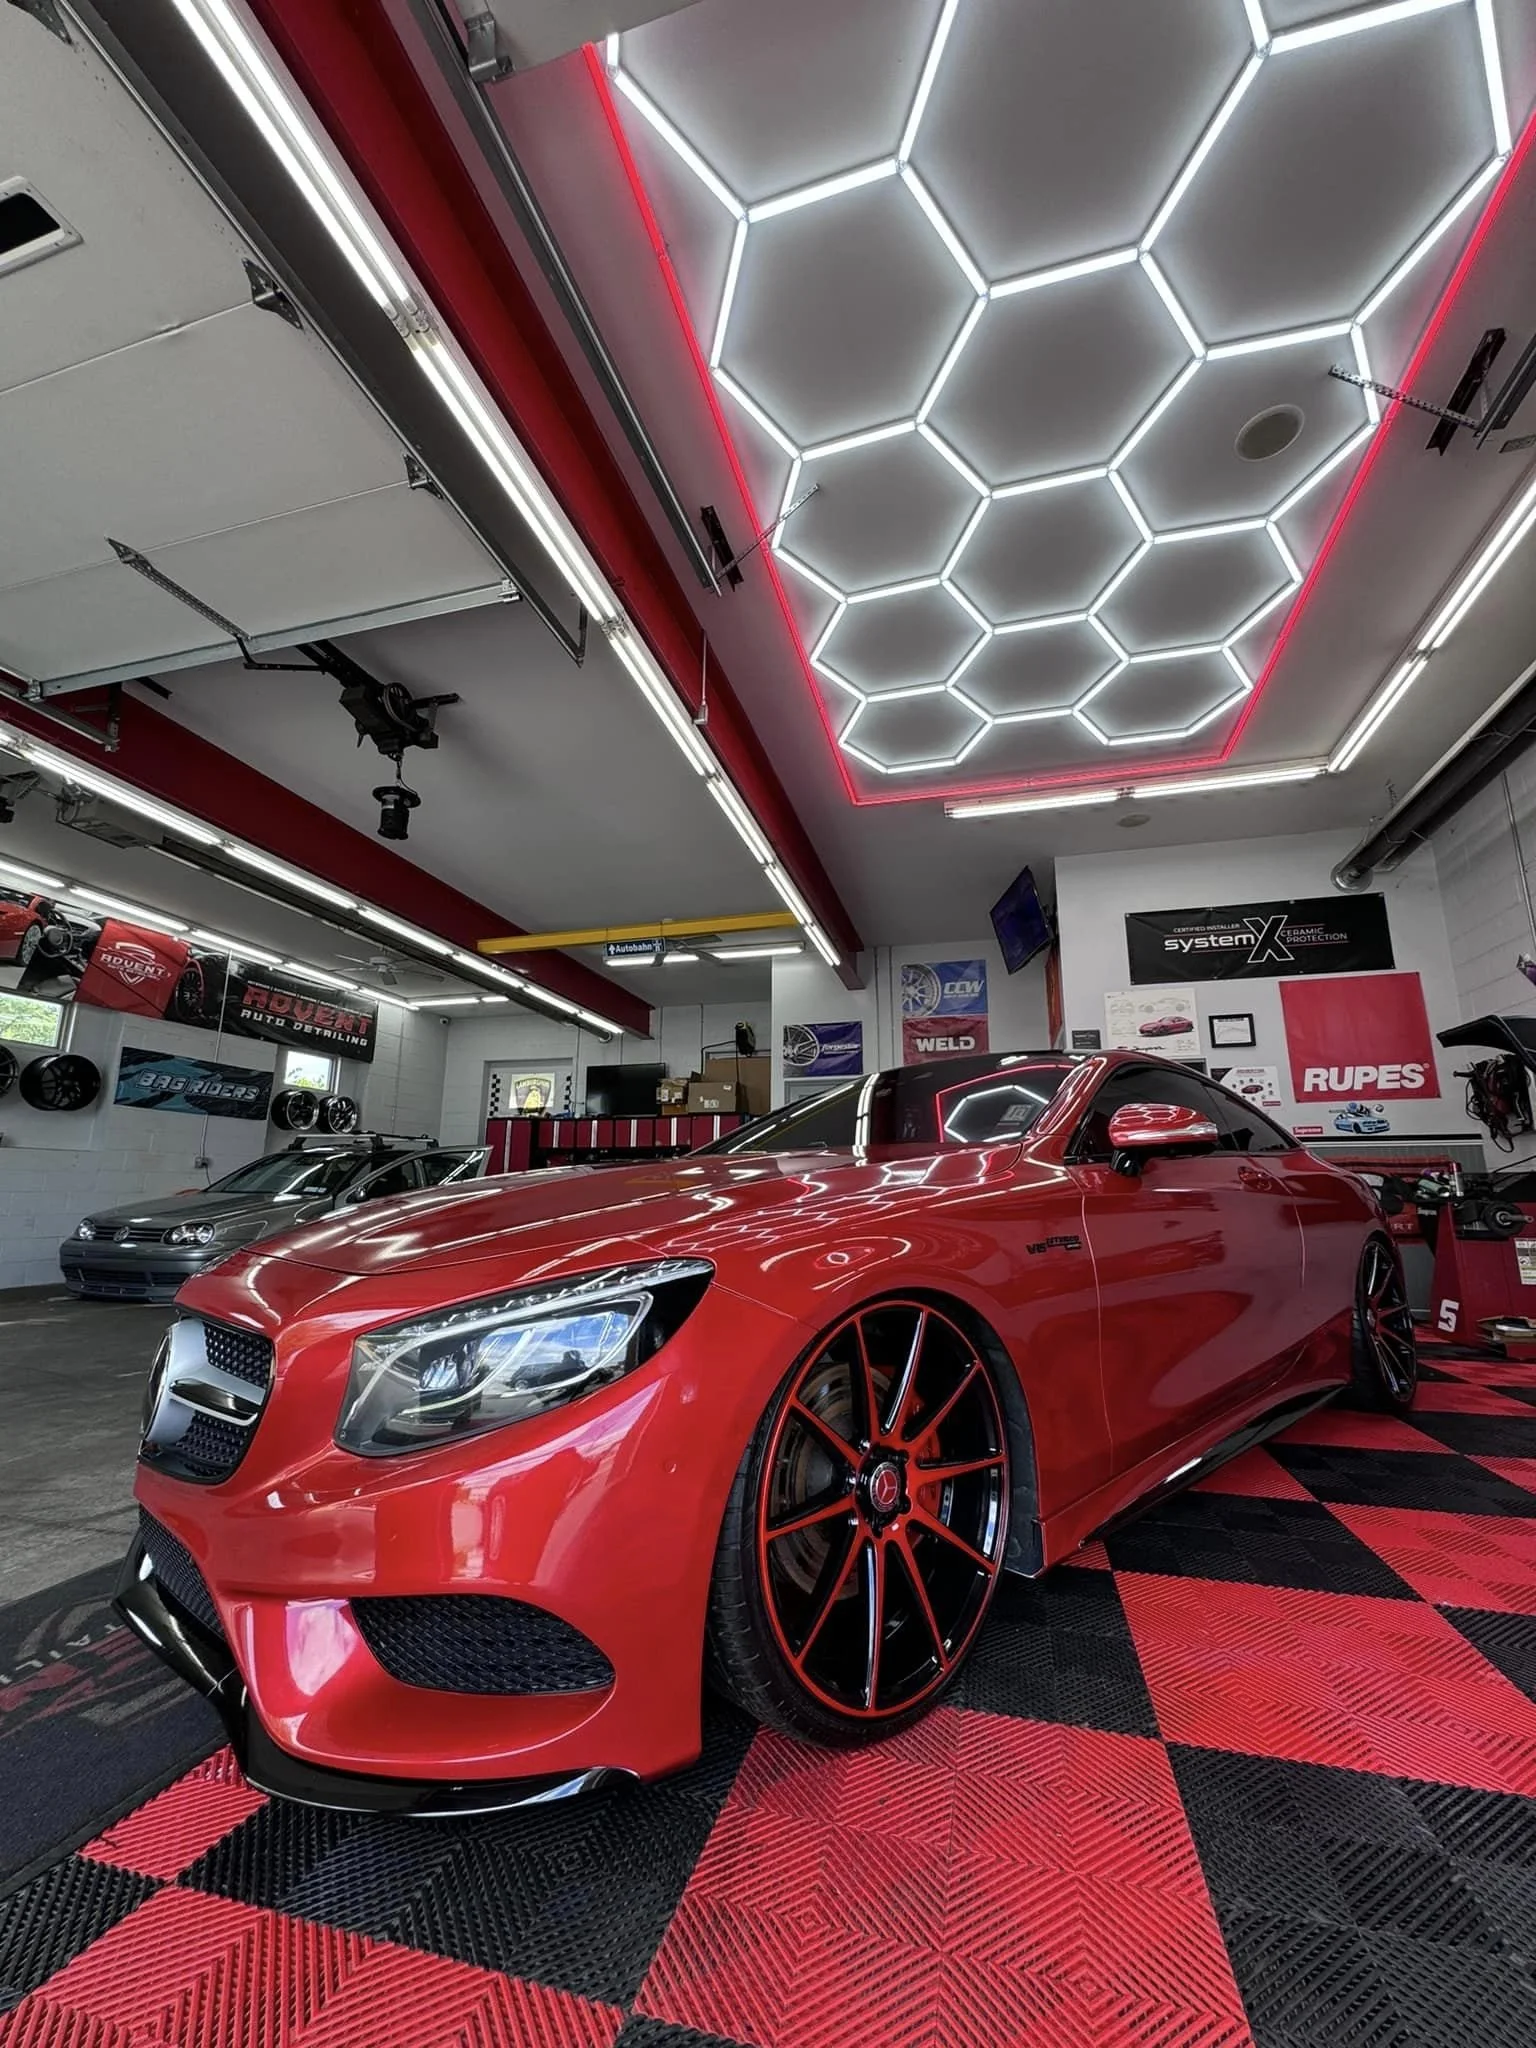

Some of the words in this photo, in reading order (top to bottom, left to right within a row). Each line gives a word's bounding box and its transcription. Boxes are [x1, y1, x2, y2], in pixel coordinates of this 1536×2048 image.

[1173, 926, 1206, 934] CERTIFIED
[1206, 923, 1241, 932] INSTALLER
[1280, 927, 1324, 938] CERAMIC
[1286, 932, 1348, 944] PROTECTION
[615, 942, 653, 953] Autobahn
[100, 953, 165, 977] ADVENT
[242, 985, 373, 1035] ADVENT
[240, 1009, 286, 1027] AUTO
[292, 1025, 368, 1047] DETAILING
[915, 1036, 976, 1052] WELD
[137, 1070, 185, 1091] BAG
[187, 1078, 259, 1101] RIDERS
[1437, 1298, 1460, 1333] 5
